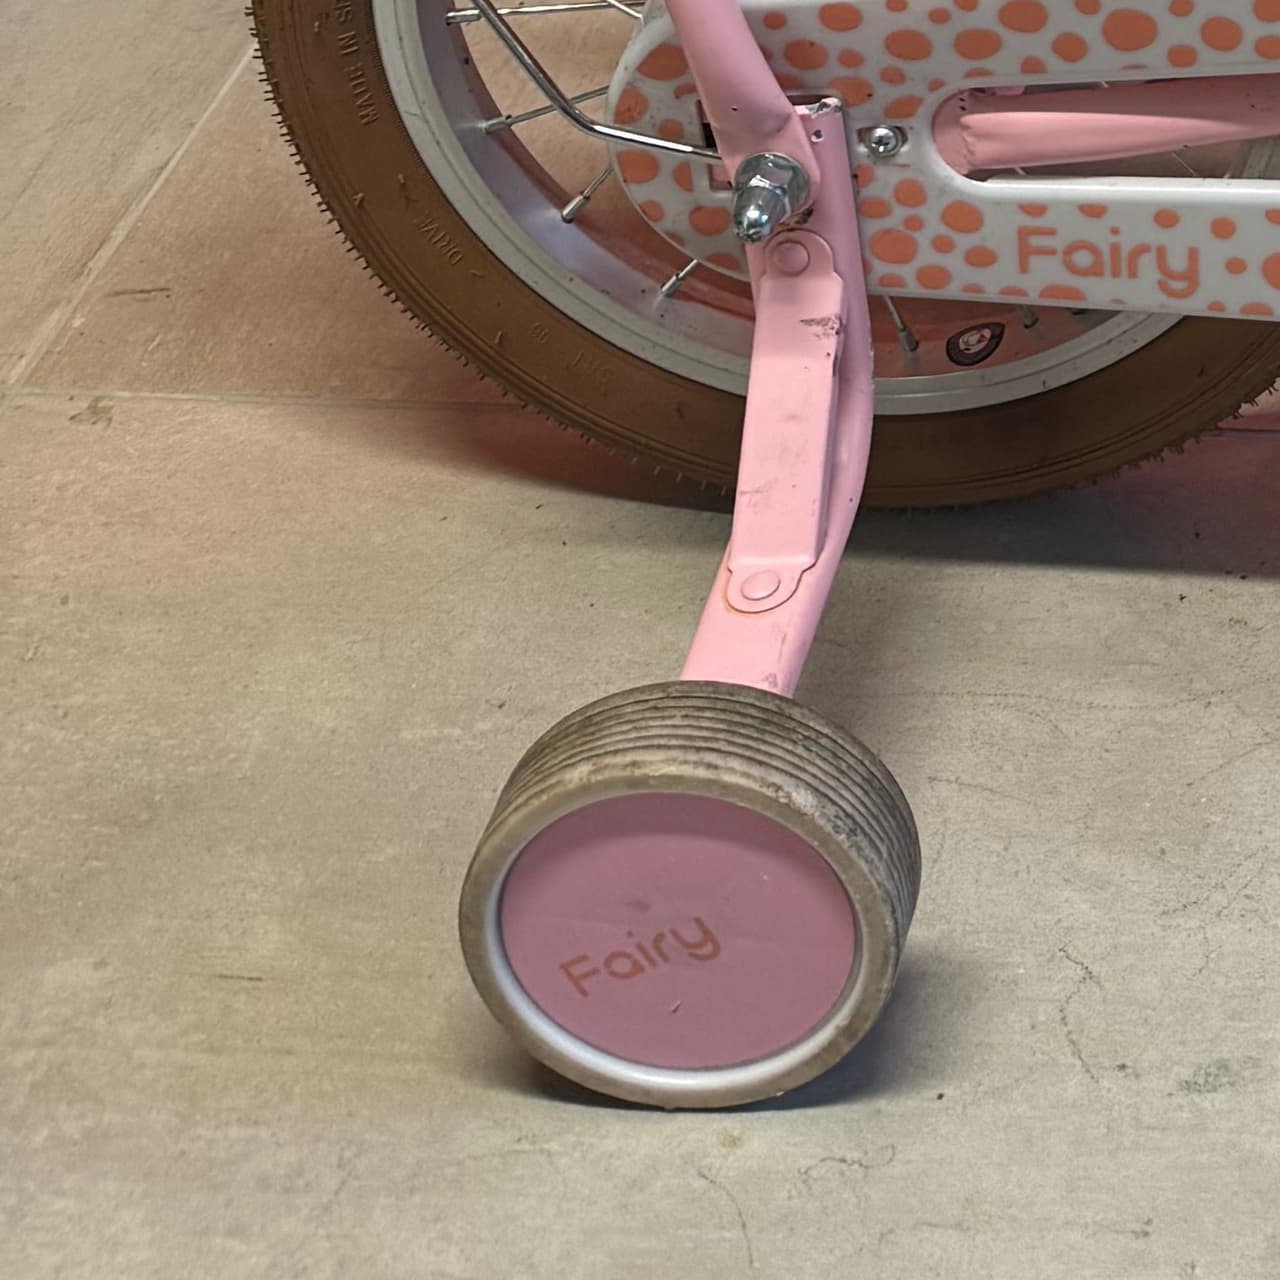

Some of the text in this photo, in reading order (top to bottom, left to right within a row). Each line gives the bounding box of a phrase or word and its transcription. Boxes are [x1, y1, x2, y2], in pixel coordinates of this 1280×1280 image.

[337, 31, 359, 56] IN
[1016, 225, 1200, 300] Fairy
[559, 916, 721, 999] Fairy
